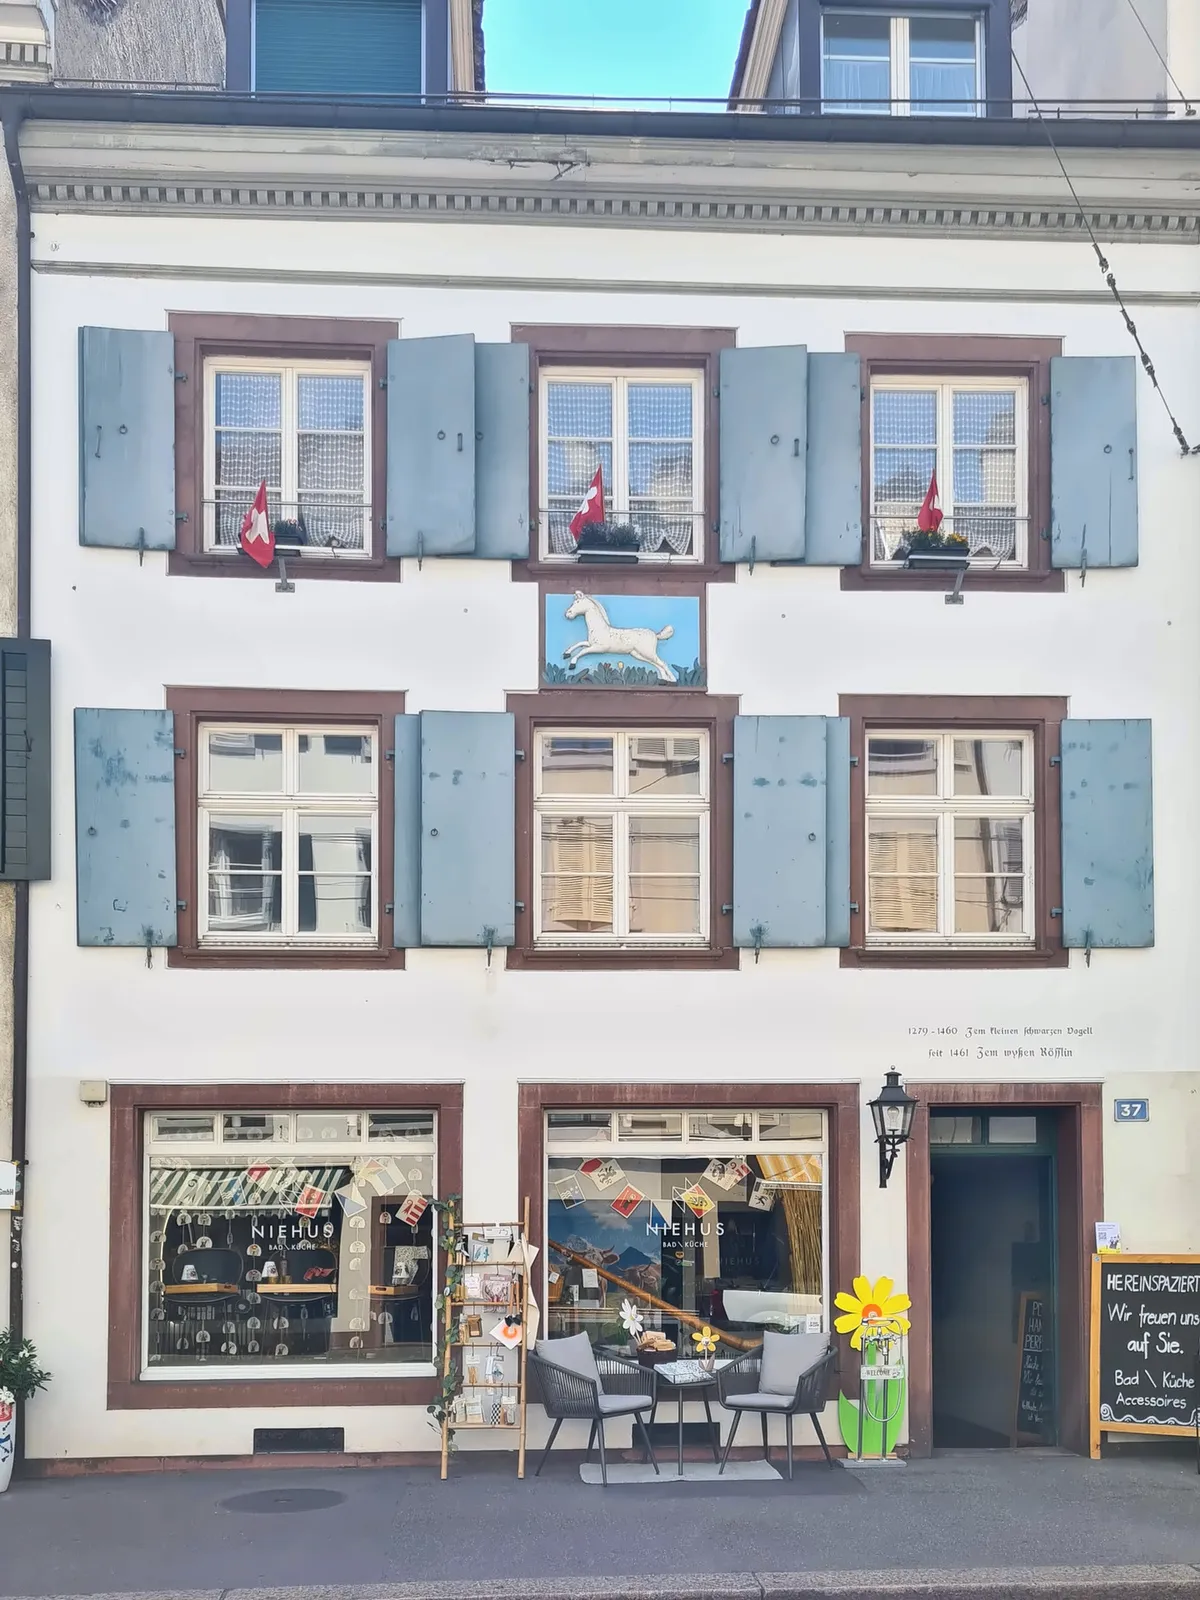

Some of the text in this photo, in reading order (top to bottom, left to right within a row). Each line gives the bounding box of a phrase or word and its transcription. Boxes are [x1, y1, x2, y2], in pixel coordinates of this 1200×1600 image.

[950, 1048, 969, 1057] 1461
[1120, 1103, 1142, 1117] 37
[251, 1224, 334, 1239] NIEHUS
[645, 1222, 725, 1236] NIEHUS
[1107, 1302, 1200, 1328] Wir freuen uns
[1127, 1331, 1184, 1360] auf Sie.
[1115, 1369, 1139, 1386] Bad
[1162, 1370, 1195, 1388] Küche
[1116, 1391, 1187, 1409] Accessoires
